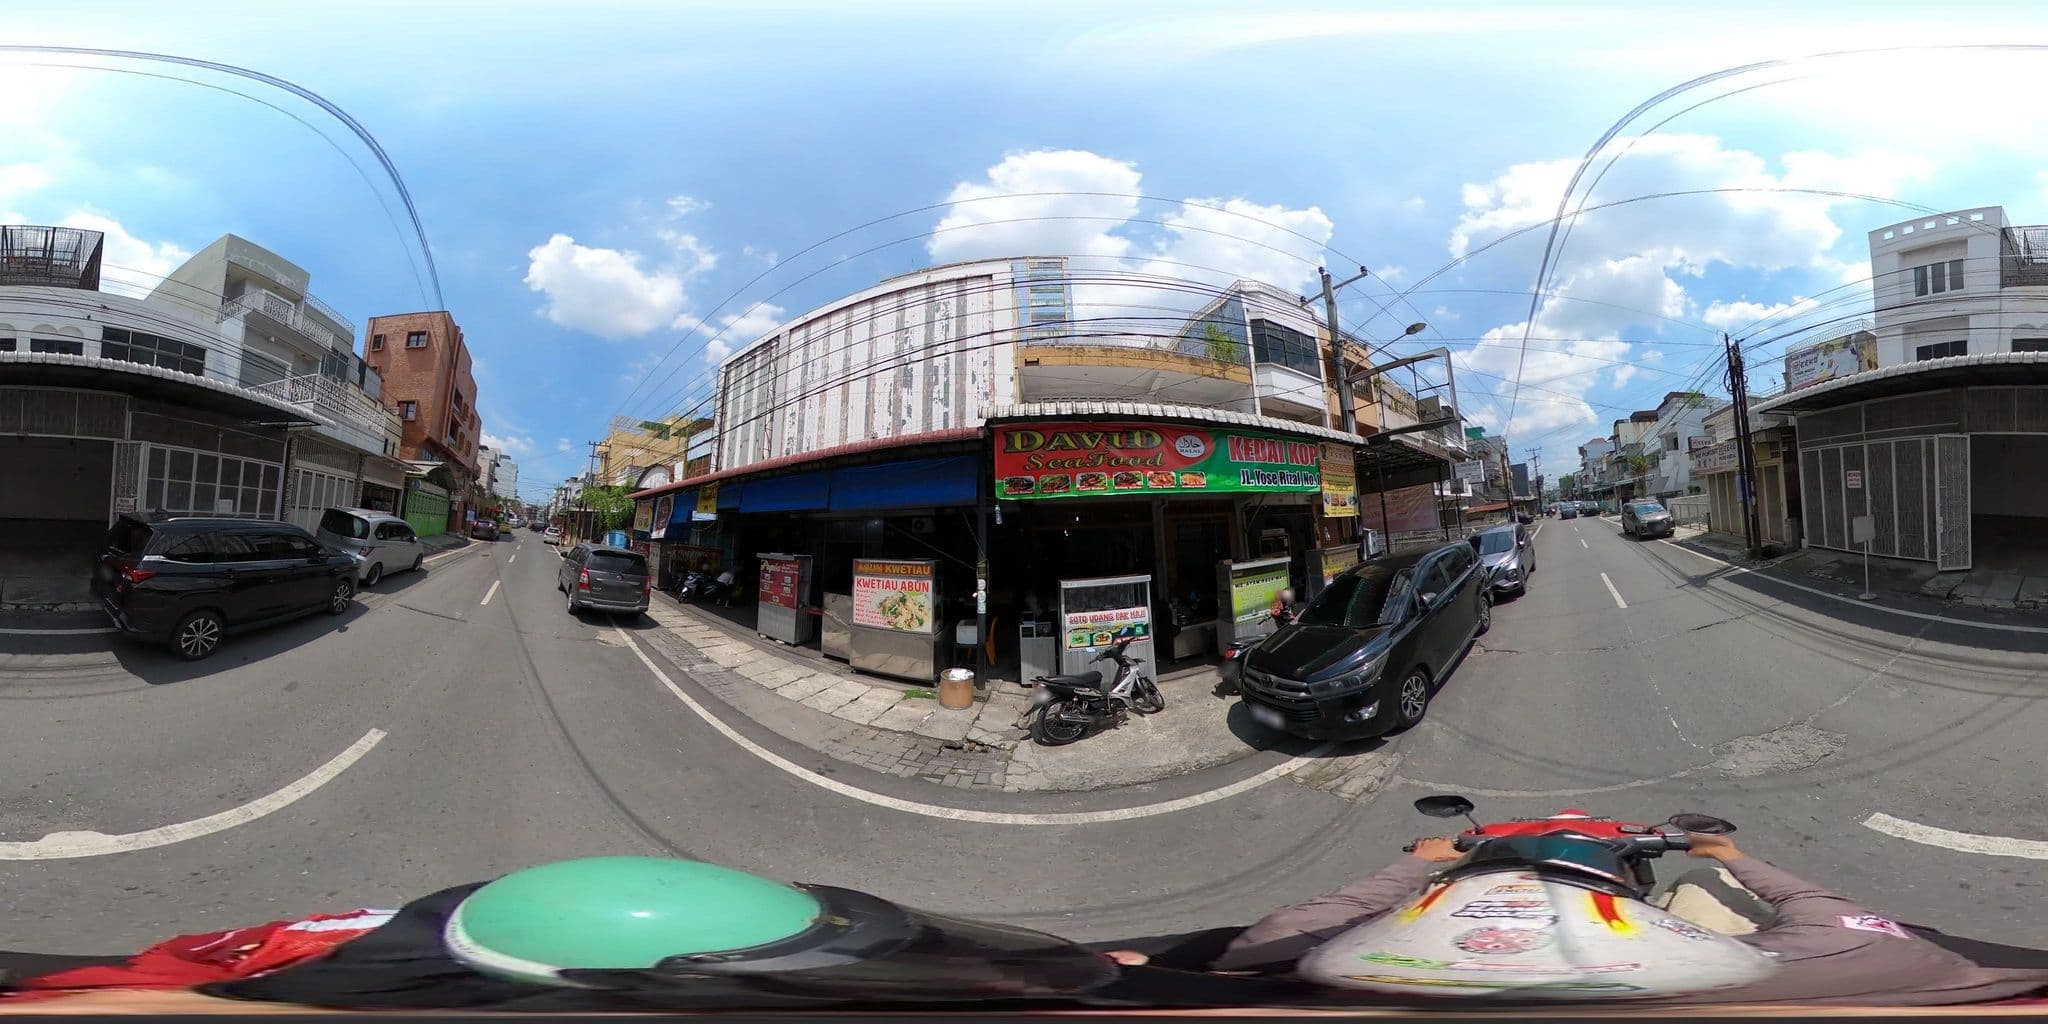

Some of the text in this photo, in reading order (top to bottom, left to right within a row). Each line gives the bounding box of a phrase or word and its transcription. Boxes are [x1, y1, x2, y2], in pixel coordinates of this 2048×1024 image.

[1003, 429, 1164, 453] DAVID
[1228, 435, 1286, 464] KEDAI
[1255, 469, 1278, 486] Yose
[1279, 470, 1300, 486] Rizal
[885, 564, 930, 575] KWETIAU
[856, 577, 929, 592] KWETIAU ABUN
[1069, 615, 1088, 625] SOTO
[1089, 613, 1114, 623] UDANG
